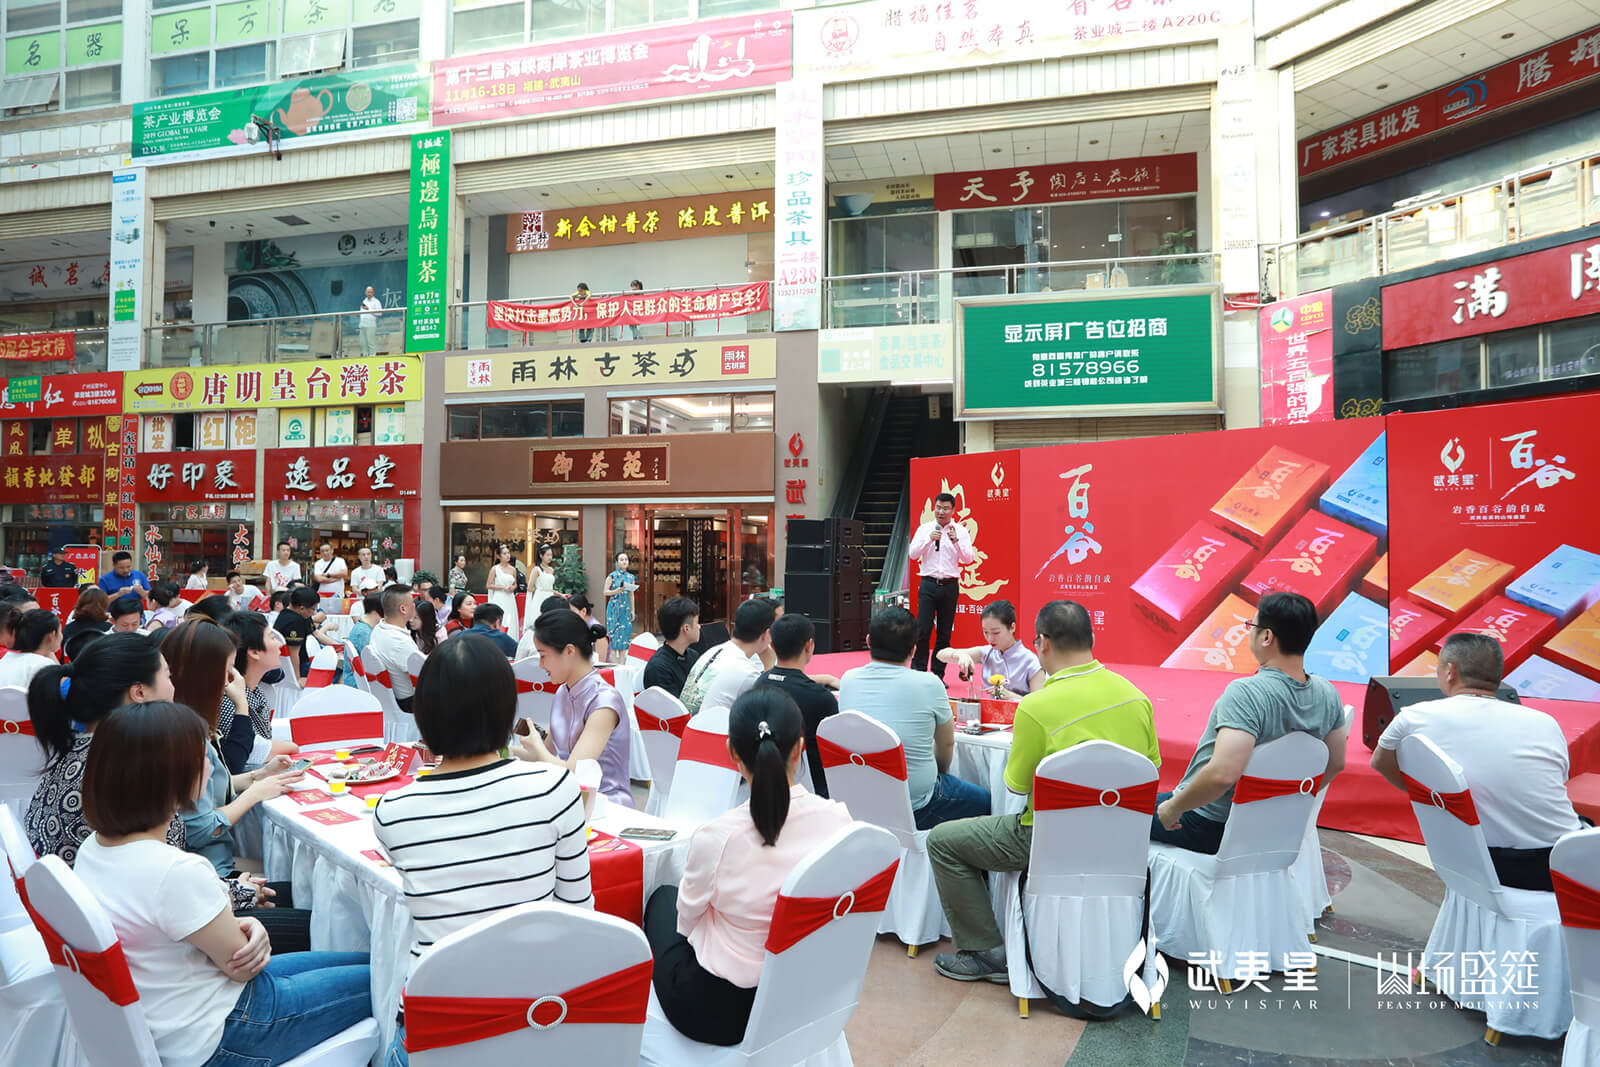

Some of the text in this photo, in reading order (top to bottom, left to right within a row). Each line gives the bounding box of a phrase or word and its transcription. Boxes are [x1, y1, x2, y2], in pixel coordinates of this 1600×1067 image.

[1161, 10, 1221, 30] A220C
[445, 43, 649, 87] 第十三届海峡两岸茶业博览会
[143, 106, 222, 129] 茶产业博览会
[157, 128, 181, 138] GLOBAL
[1303, 105, 1420, 167] 厂家茶具批发
[418, 153, 441, 284] 極邊烏龍茶
[554, 200, 770, 241] 新会柑普茶 陈皮普洱
[777, 267, 818, 287] A238
[1004, 317, 1168, 343] 显示屏广告位招商
[511, 348, 698, 384] 雨林古茶坊
[1032, 360, 1140, 377] 81578966
[200, 362, 408, 406] 唐明皇台灣茶
[151, 416, 166, 450] 批发
[203, 415, 257, 448] 红袍
[146, 460, 240, 491] 好印象
[285, 454, 397, 492] 逸品堂
[1433, 474, 1475, 487] 武夷星
